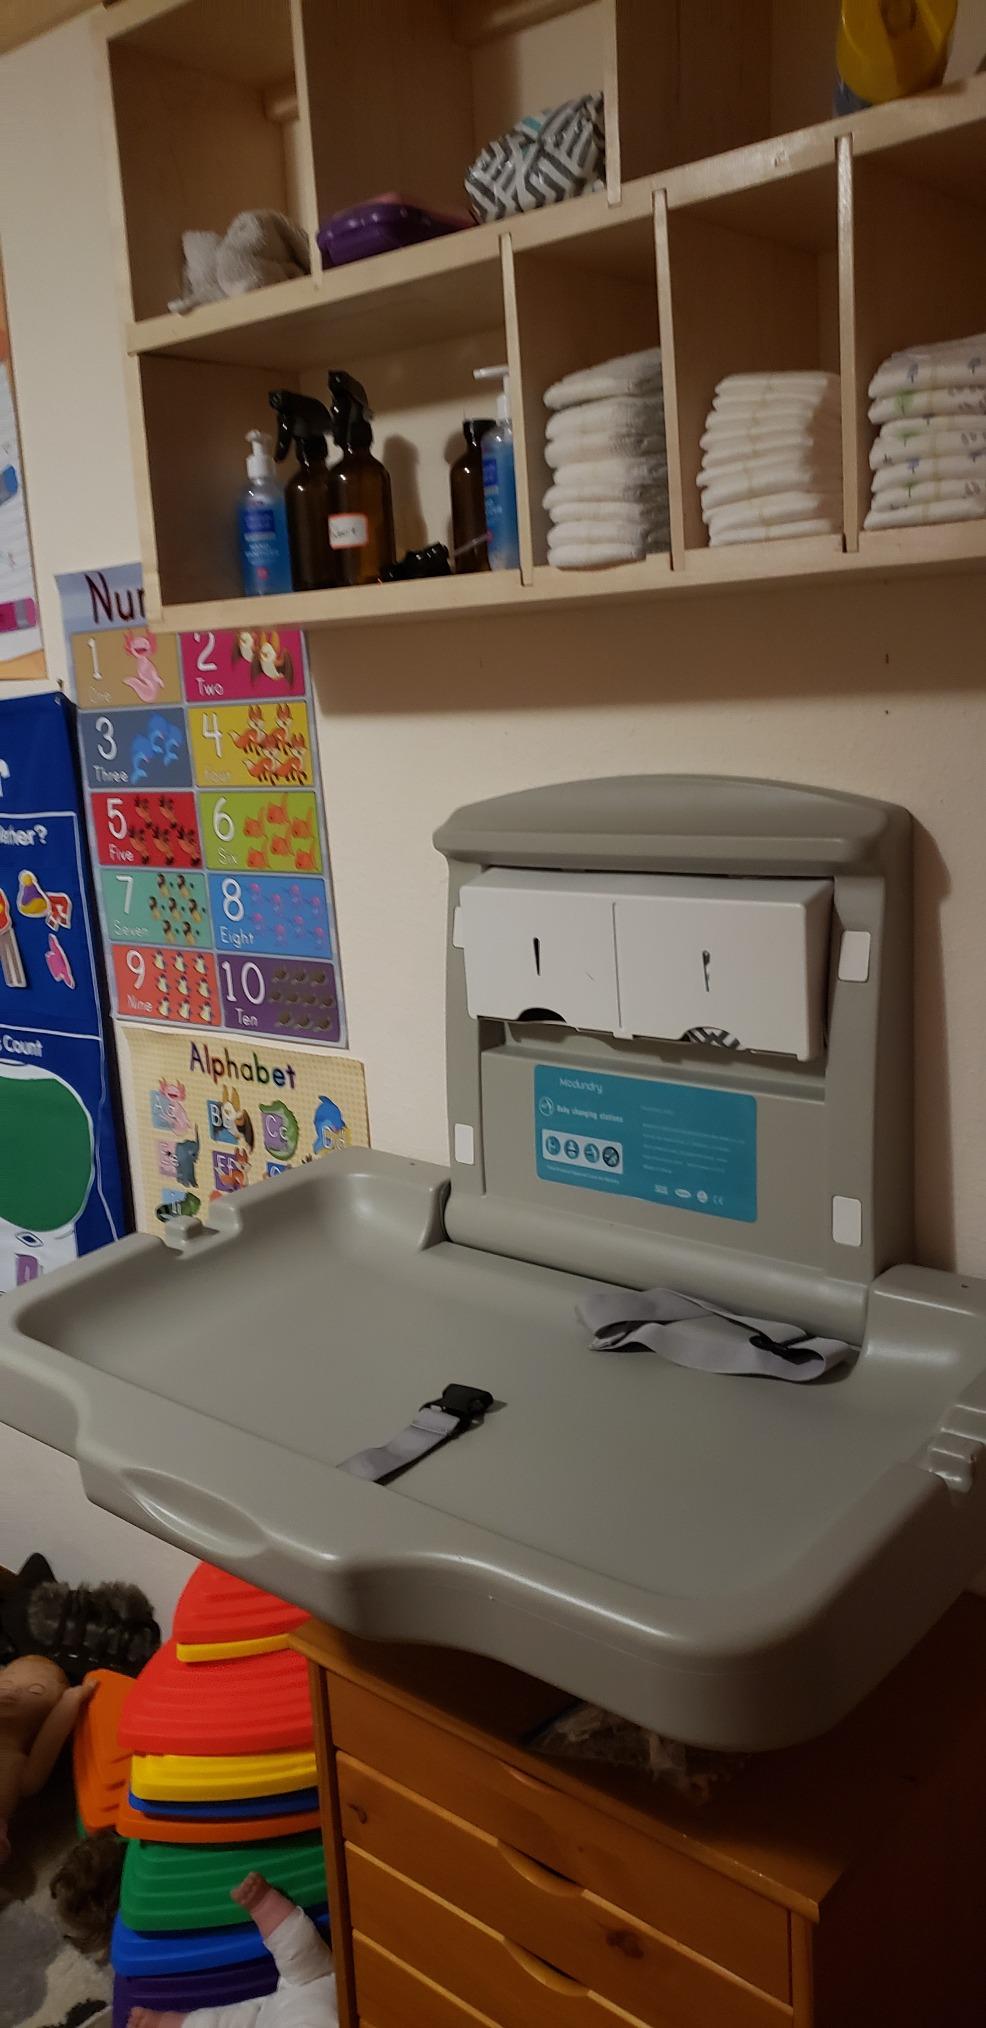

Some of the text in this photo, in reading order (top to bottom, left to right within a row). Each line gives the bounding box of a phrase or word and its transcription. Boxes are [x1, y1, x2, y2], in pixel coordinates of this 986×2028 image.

[87, 638, 102, 680] 1
[193, 632, 217, 671] 2
[197, 679, 224, 696] Two
[95, 716, 118, 760] 3
[202, 712, 223, 758] 4
[93, 764, 129, 783] Three
[106, 798, 128, 840] 5
[212, 797, 235, 842] 6
[108, 844, 134, 862] Five
[217, 847, 239, 865] Six
[115, 874, 134, 914] 7
[221, 877, 245, 922] 8
[112, 919, 150, 937] Seven
[219, 926, 255, 948] Eight
[126, 950, 145, 990] 9
[221, 960, 266, 1005] 10
[127, 994, 153, 1012] Nine
[234, 1007, 259, 1028] Ten
[3, 1034, 43, 1057] Count
[189, 1041, 296, 1089] Alphabet
[265, 1114, 289, 1141] Cc
